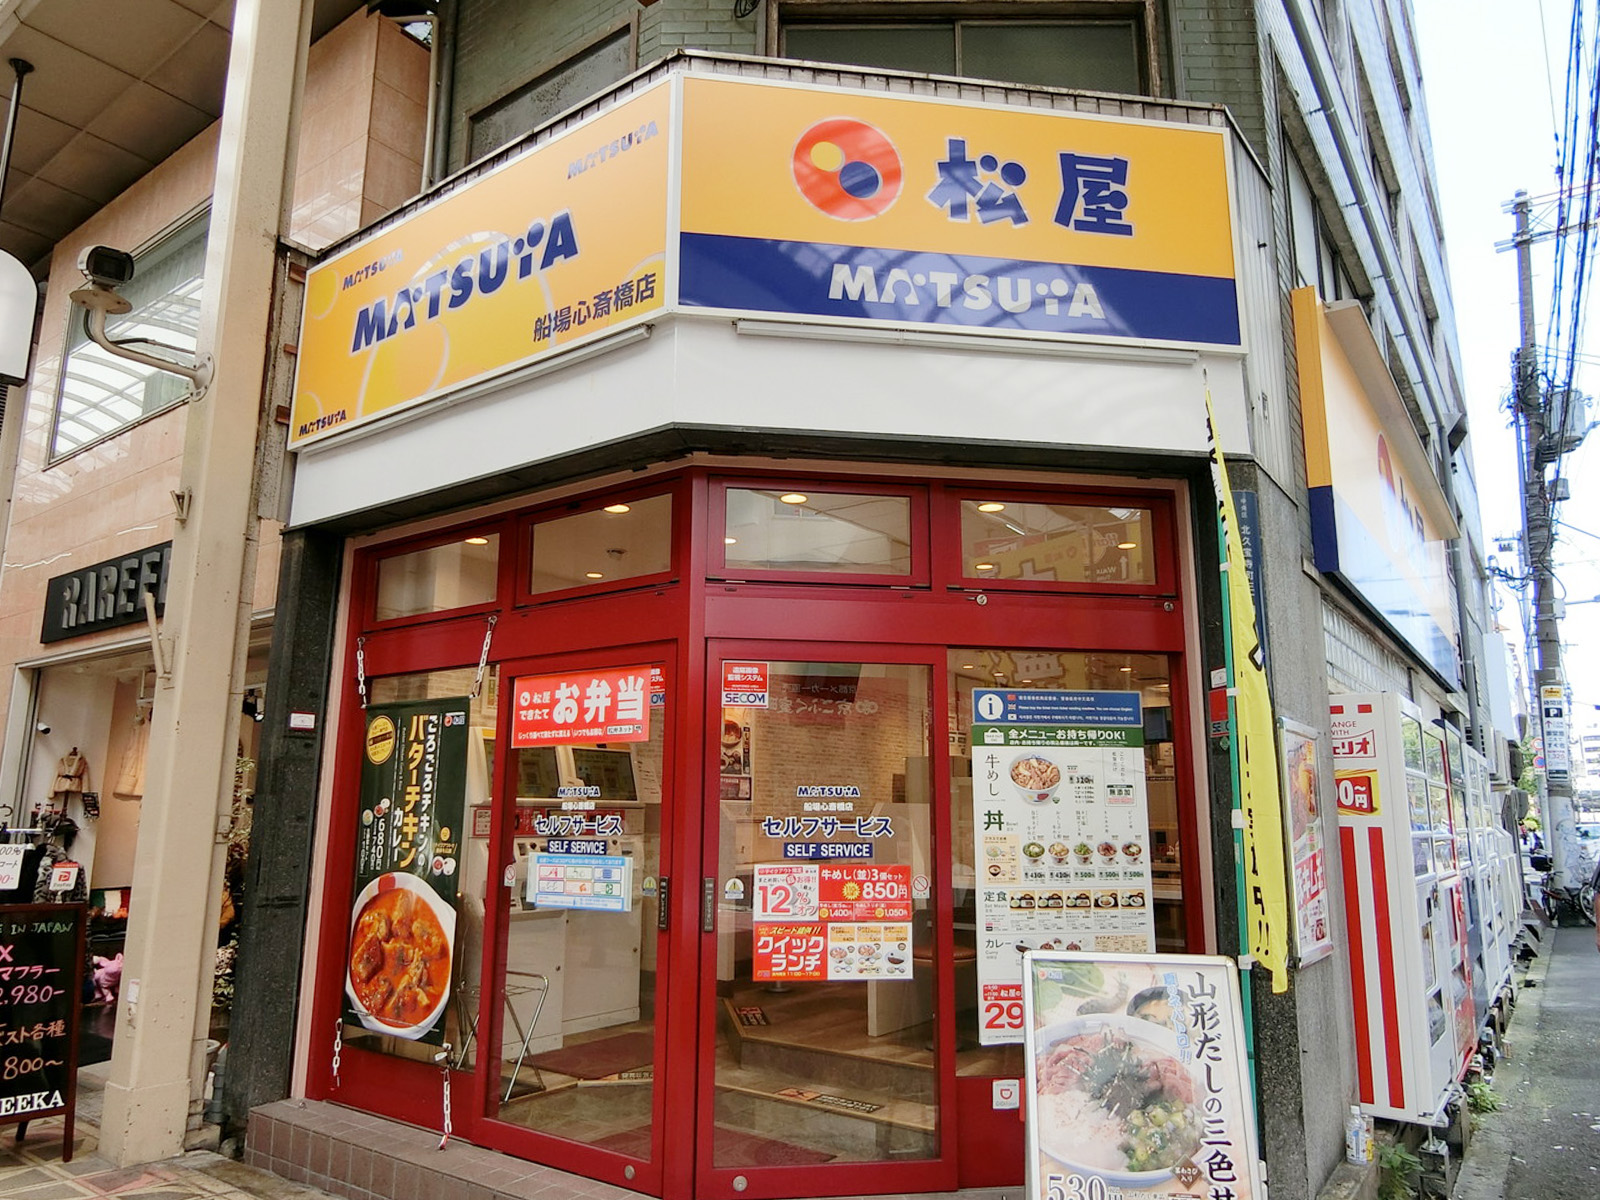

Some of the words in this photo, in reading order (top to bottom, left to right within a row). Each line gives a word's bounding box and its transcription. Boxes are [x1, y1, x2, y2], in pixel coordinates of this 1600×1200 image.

[567, 120, 659, 179] MATSUYA
[926, 137, 1134, 238] 松屋
[351, 212, 579, 353] MATSUYA
[827, 264, 1106, 320] MATSUYA
[532, 272, 657, 343] 船場心斎橋店
[298, 409, 347, 437] MATSUYA
[62, 547, 172, 629] RAREE
[553, 675, 645, 724] お弁当
[725, 693, 765, 704] SECOM
[519, 709, 550, 721] できたて
[1549, 708, 1557, 717] P
[985, 754, 1000, 796] 牛めし
[400, 714, 429, 869] バターチキン
[559, 787, 600, 797] MATSUYA
[798, 786, 860, 797] MATSUYA
[536, 815, 623, 836] セルフサービス
[763, 817, 893, 837] セルフサービス
[984, 810, 1005, 831] 丼
[392, 807, 405, 862] カレー
[549, 841, 568, 853] SELF
[570, 841, 605, 854] SERVICE
[786, 844, 815, 857] SELF
[820, 844, 870, 857] SERVICE
[758, 885, 792, 914] 12
[984, 891, 1007, 902] 定食
[11, 924, 26, 934] IN
[31, 922, 73, 934] JAPAN
[757, 936, 825, 953] クイック
[985, 939, 1012, 948] カレー
[1, 965, 61, 981] マフラー
[771, 954, 821, 972] ランチ
[1000, 988, 1023, 997] 松屋の
[0, 1019, 67, 1046] スト各種
